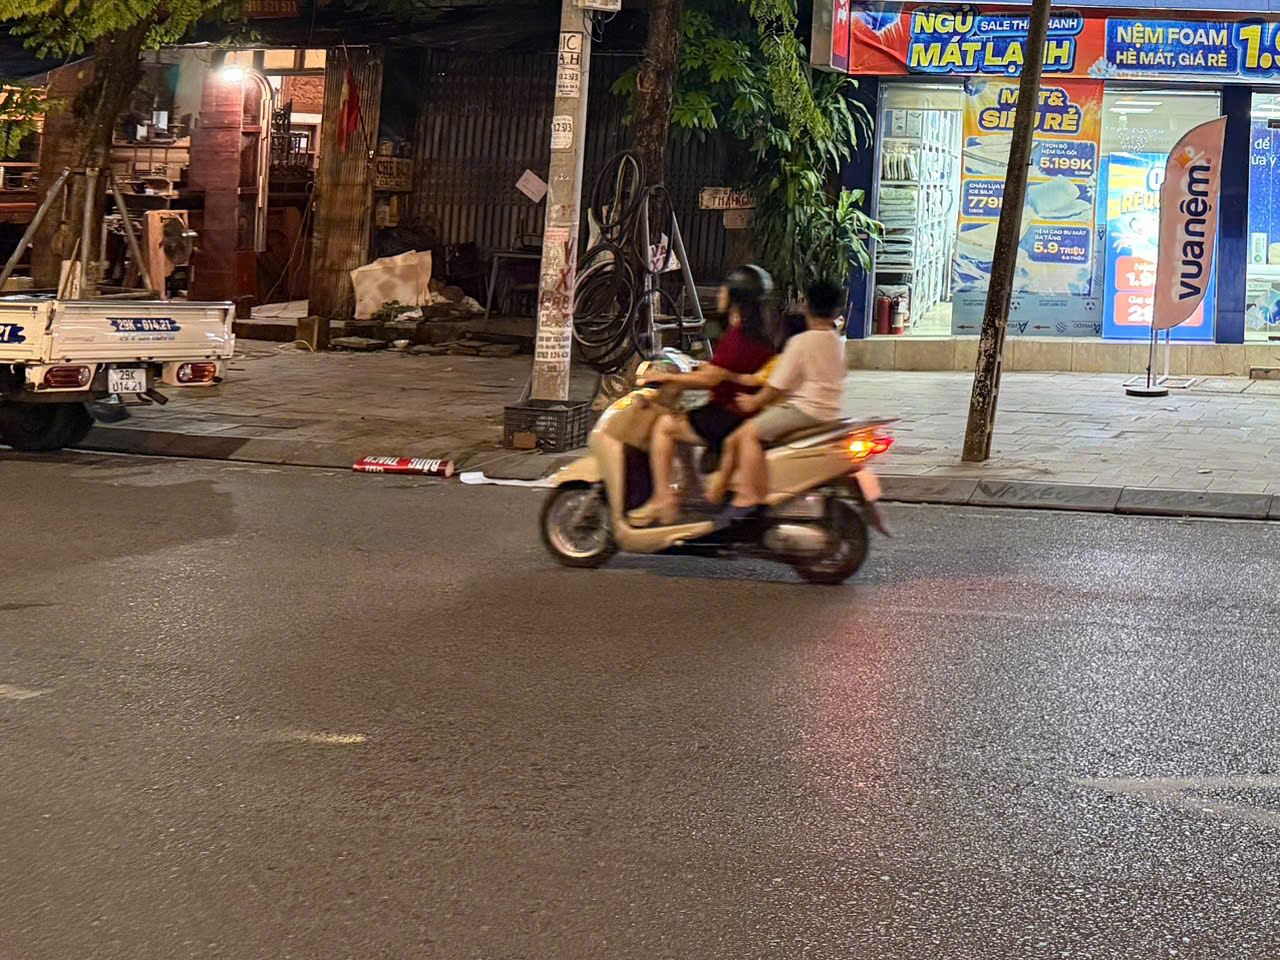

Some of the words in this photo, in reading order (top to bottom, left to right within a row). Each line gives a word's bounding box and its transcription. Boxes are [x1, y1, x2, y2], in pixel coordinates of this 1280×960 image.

[914, 5, 974, 34] NGỦ
[980, 20, 1009, 31] SALE
[1117, 23, 1164, 48] NỆM
[1168, 28, 1228, 46] FOAM
[911, 35, 982, 67] MÁT
[984, 40, 1070, 73] LẠH
[1116, 50, 1137, 64] HÈ
[1179, 51, 1205, 66] GIÁ
[1208, 50, 1228, 67] RẺ
[1044, 108, 1078, 131] RẺ
[1040, 157, 1092, 170] 5.199K
[1034, 242, 1059, 254] 5.9
